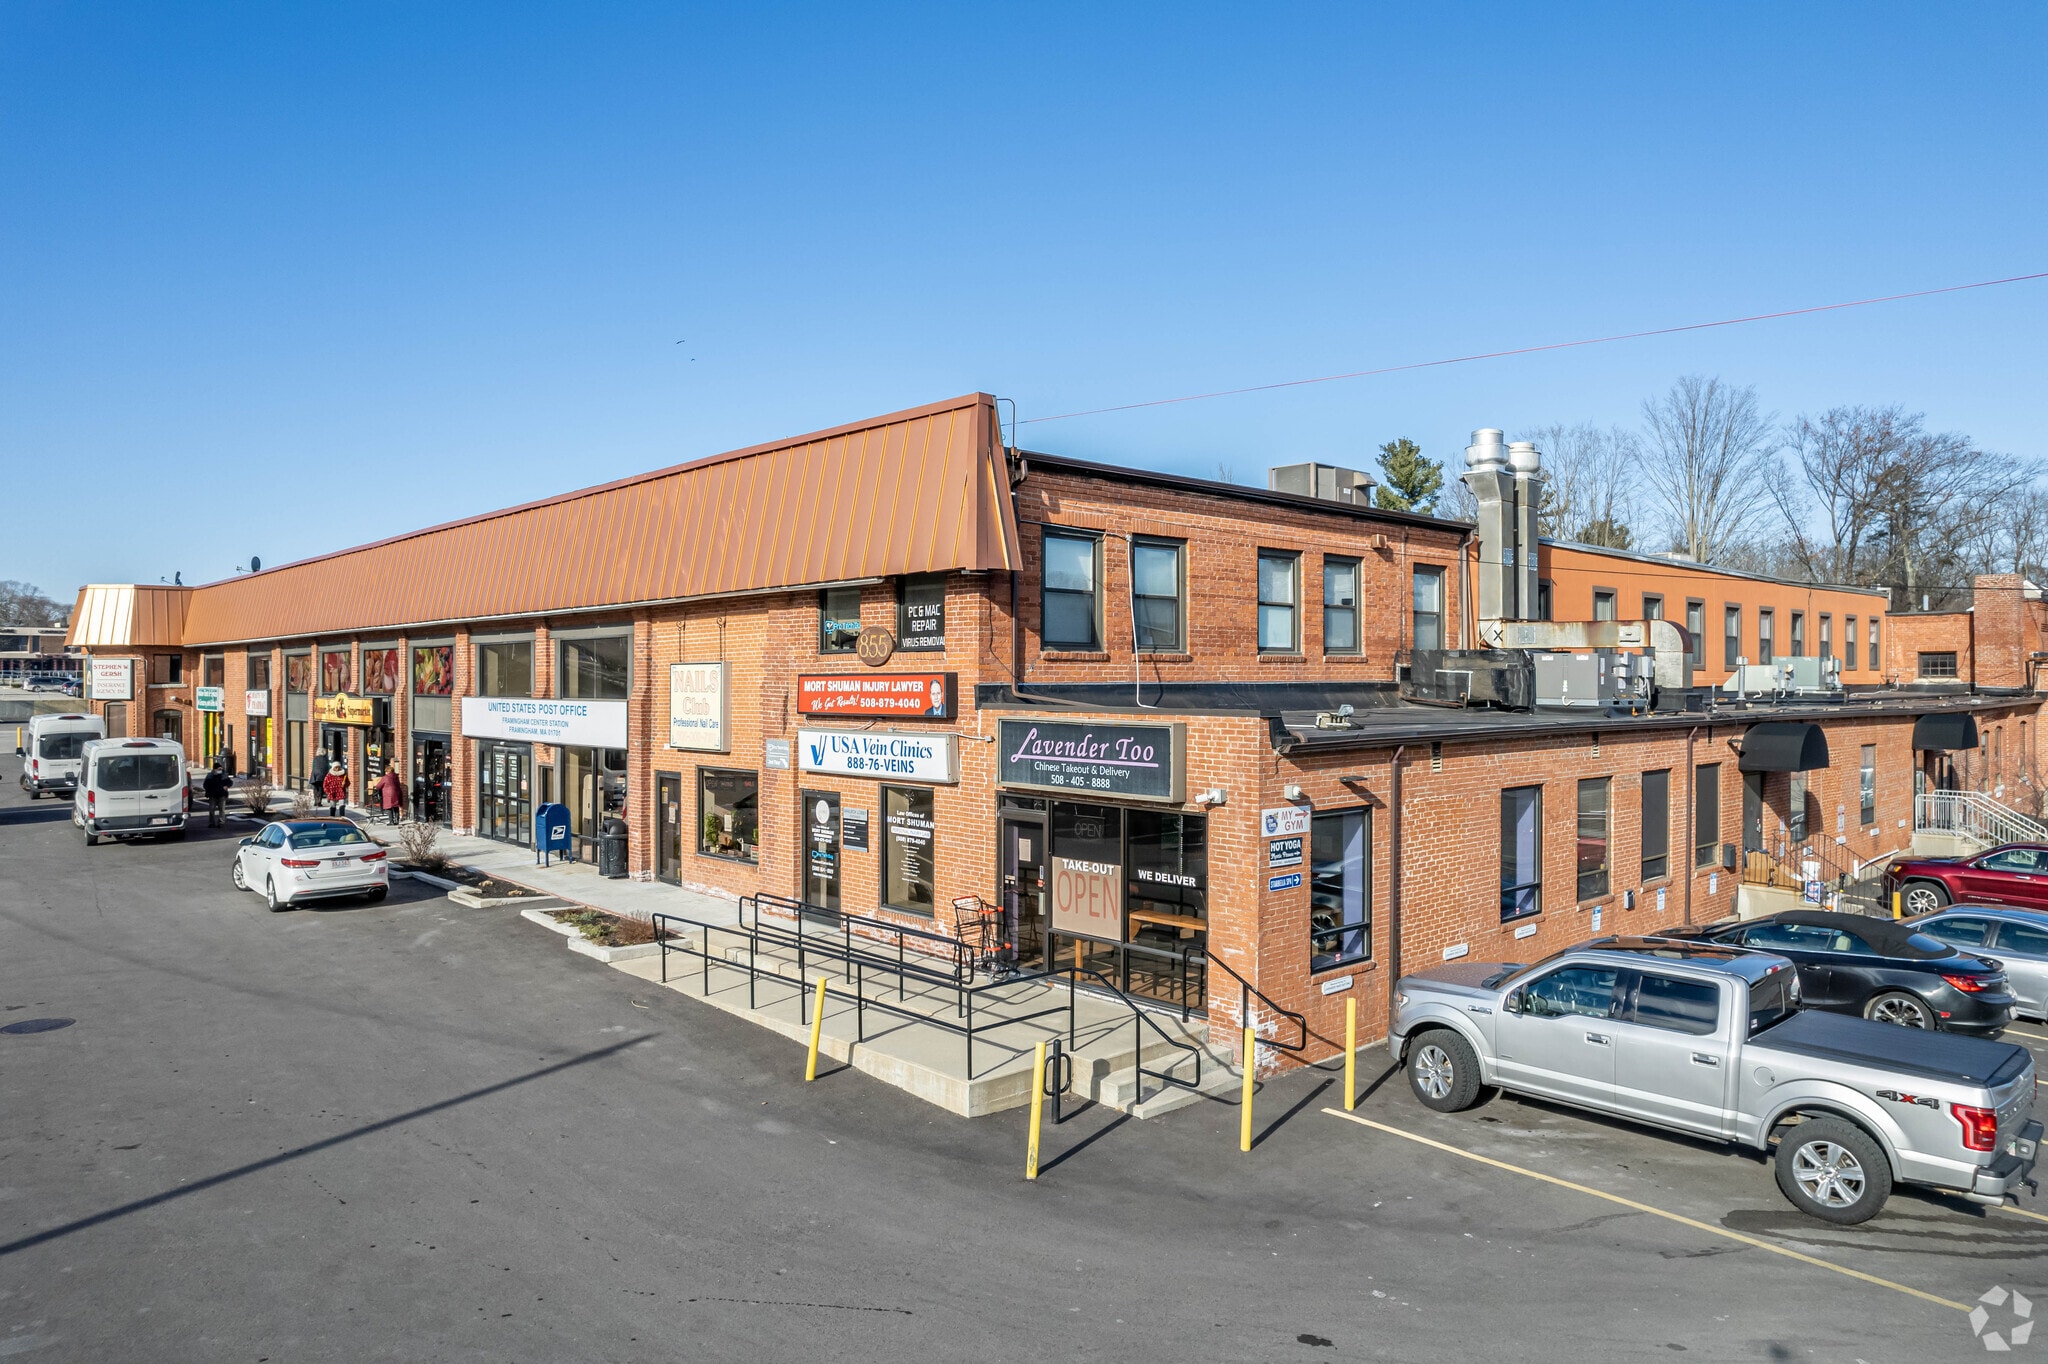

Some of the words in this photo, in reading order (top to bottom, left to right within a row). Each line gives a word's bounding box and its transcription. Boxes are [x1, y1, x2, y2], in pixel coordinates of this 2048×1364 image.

[908, 606, 918, 618] PC
[918, 606, 924, 617] &
[924, 604, 940, 616] MAC
[912, 619, 936, 632] REPAIR
[859, 634, 888, 658] 855
[902, 637, 920, 648] VIRUS
[674, 670, 720, 694] NAILS
[804, 681, 826, 692] MORT
[828, 680, 860, 692] SHUMAN
[862, 681, 890, 692] INJURY
[891, 682, 924, 692] LAWYER
[488, 702, 510, 712] UNITED
[512, 703, 536, 714] STATES
[538, 704, 558, 715] POST
[560, 706, 588, 716] OFFICE
[682, 696, 710, 716] Club
[860, 698, 920, 708] 508-879-4040
[502, 716, 530, 724] FRAMINGHAM
[508, 726, 538, 734] FRAMINGHAM,
[831, 736, 858, 754] USA
[862, 738, 887, 756] Vein
[890, 739, 932, 758] Clinics
[1010, 727, 1108, 763] Lavender
[1115, 737, 1154, 762] Too
[846, 756, 914, 774] 888-76-VEINS
[1034, 762, 1060, 773] Chinese
[1062, 764, 1090, 775] Takeout
[1091, 766, 1098, 774] &
[1100, 766, 1130, 778] Delivery
[1050, 775, 1064, 785] 508
[1071, 776, 1084, 786] 405
[1091, 778, 1110, 788] 8888
[1282, 810, 1293, 820] MY
[887, 816, 905, 824] MORT
[906, 818, 934, 829] SHUMAN
[1284, 820, 1304, 831] GYM
[1074, 822, 1100, 838] OPEN
[1270, 842, 1284, 852] HOT
[1284, 840, 1300, 851] YOGA
[1062, 858, 1114, 875] TAKE-OUT
[1138, 870, 1152, 880] WE
[1155, 872, 1196, 886] DELIVER
[1056, 870, 1118, 920] OPEN
